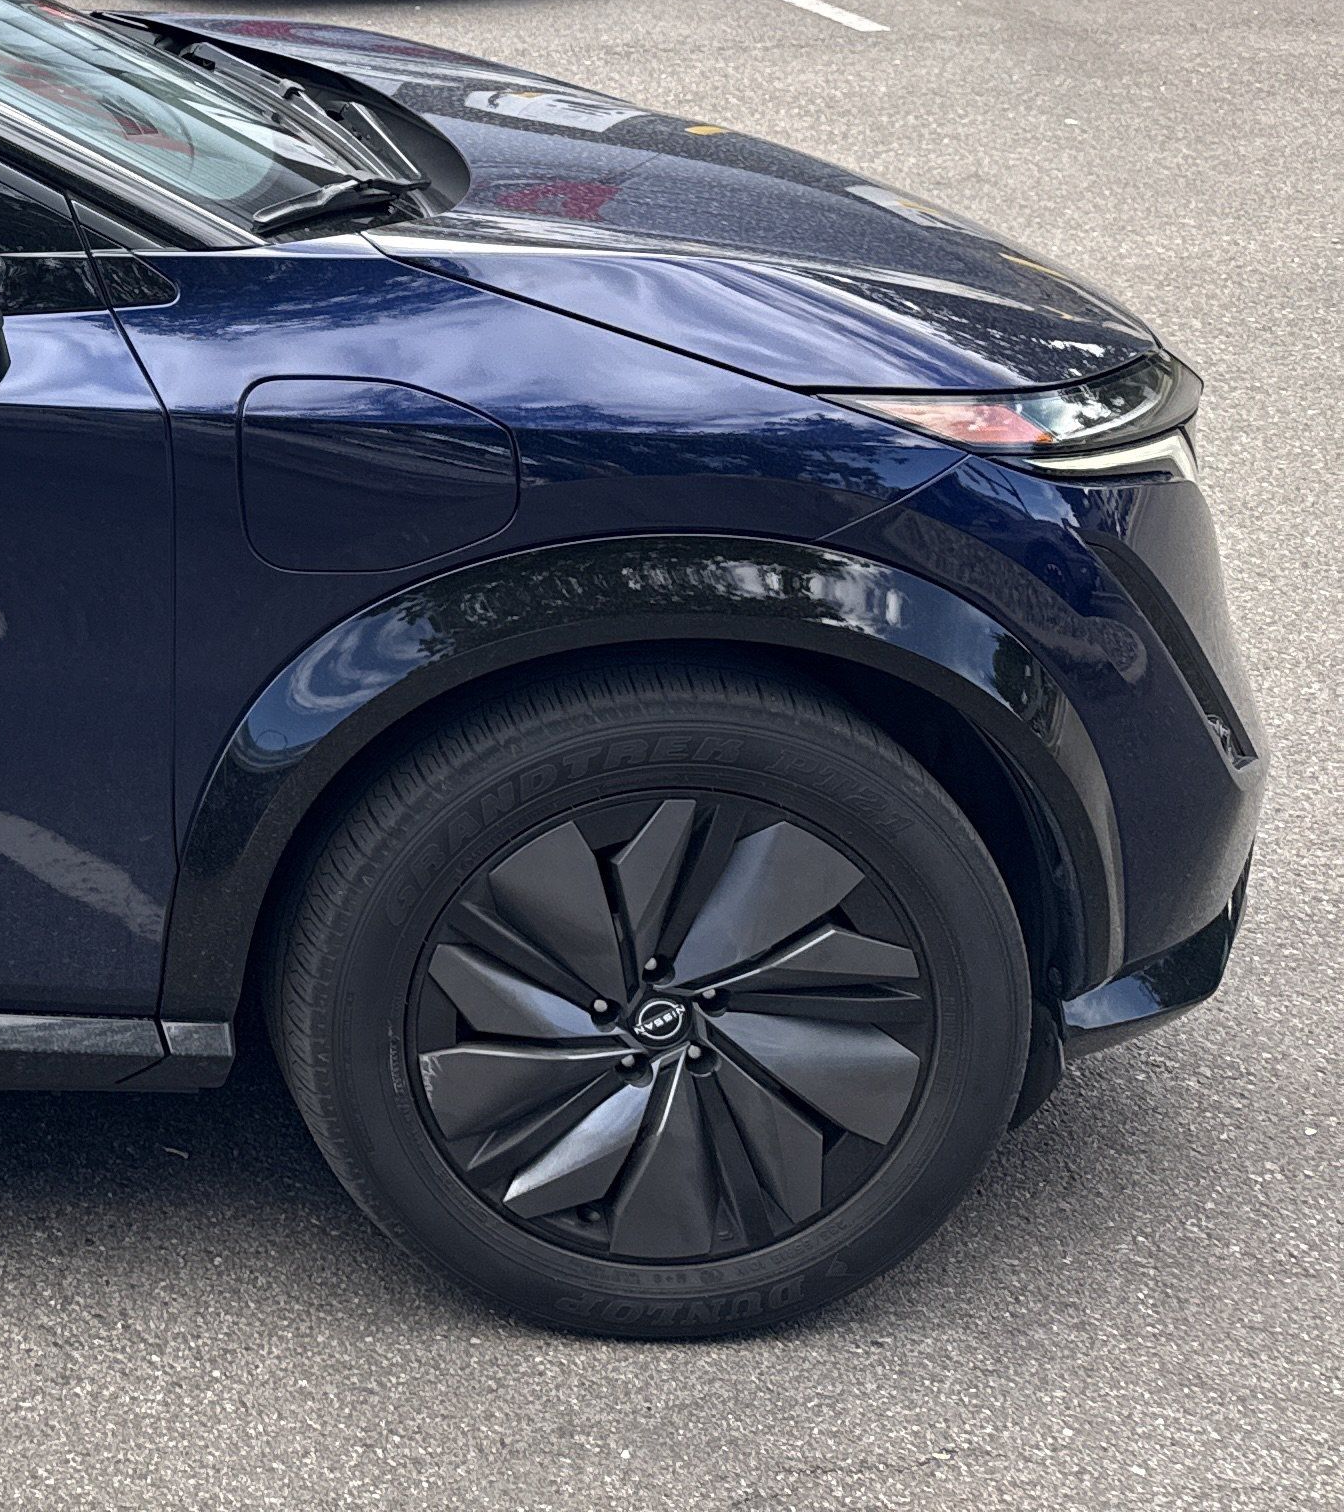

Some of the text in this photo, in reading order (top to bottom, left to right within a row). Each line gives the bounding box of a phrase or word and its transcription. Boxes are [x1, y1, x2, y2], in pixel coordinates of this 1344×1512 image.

[386, 735, 746, 926] GRANDTREK
[764, 749, 918, 839] PT21
[633, 1004, 685, 1035] NISSAN
[553, 1275, 806, 1326] DUNLOP
